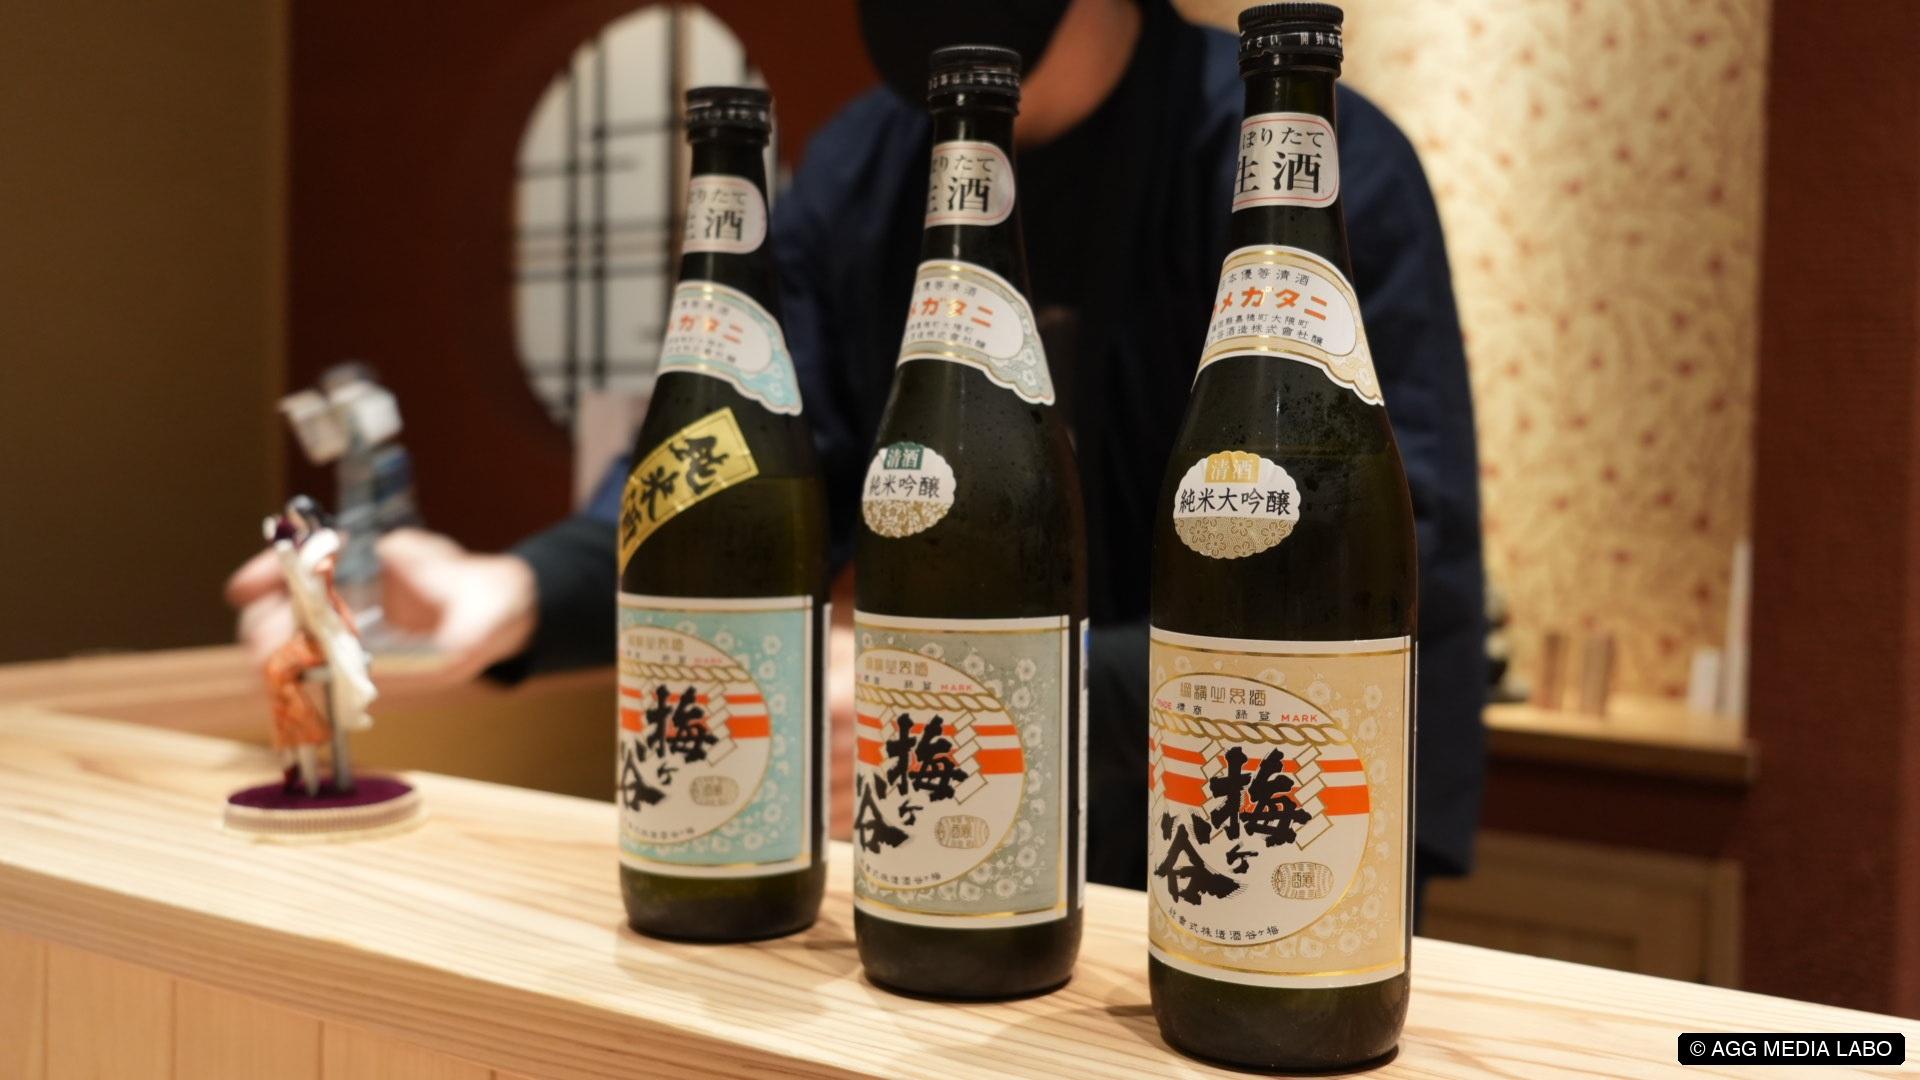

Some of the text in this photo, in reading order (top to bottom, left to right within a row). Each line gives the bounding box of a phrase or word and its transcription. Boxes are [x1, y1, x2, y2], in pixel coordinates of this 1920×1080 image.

[1210, 286, 1328, 322] メガタニ
[1179, 487, 1292, 516] 純米大吟醸
[1281, 713, 1318, 723] MARK
